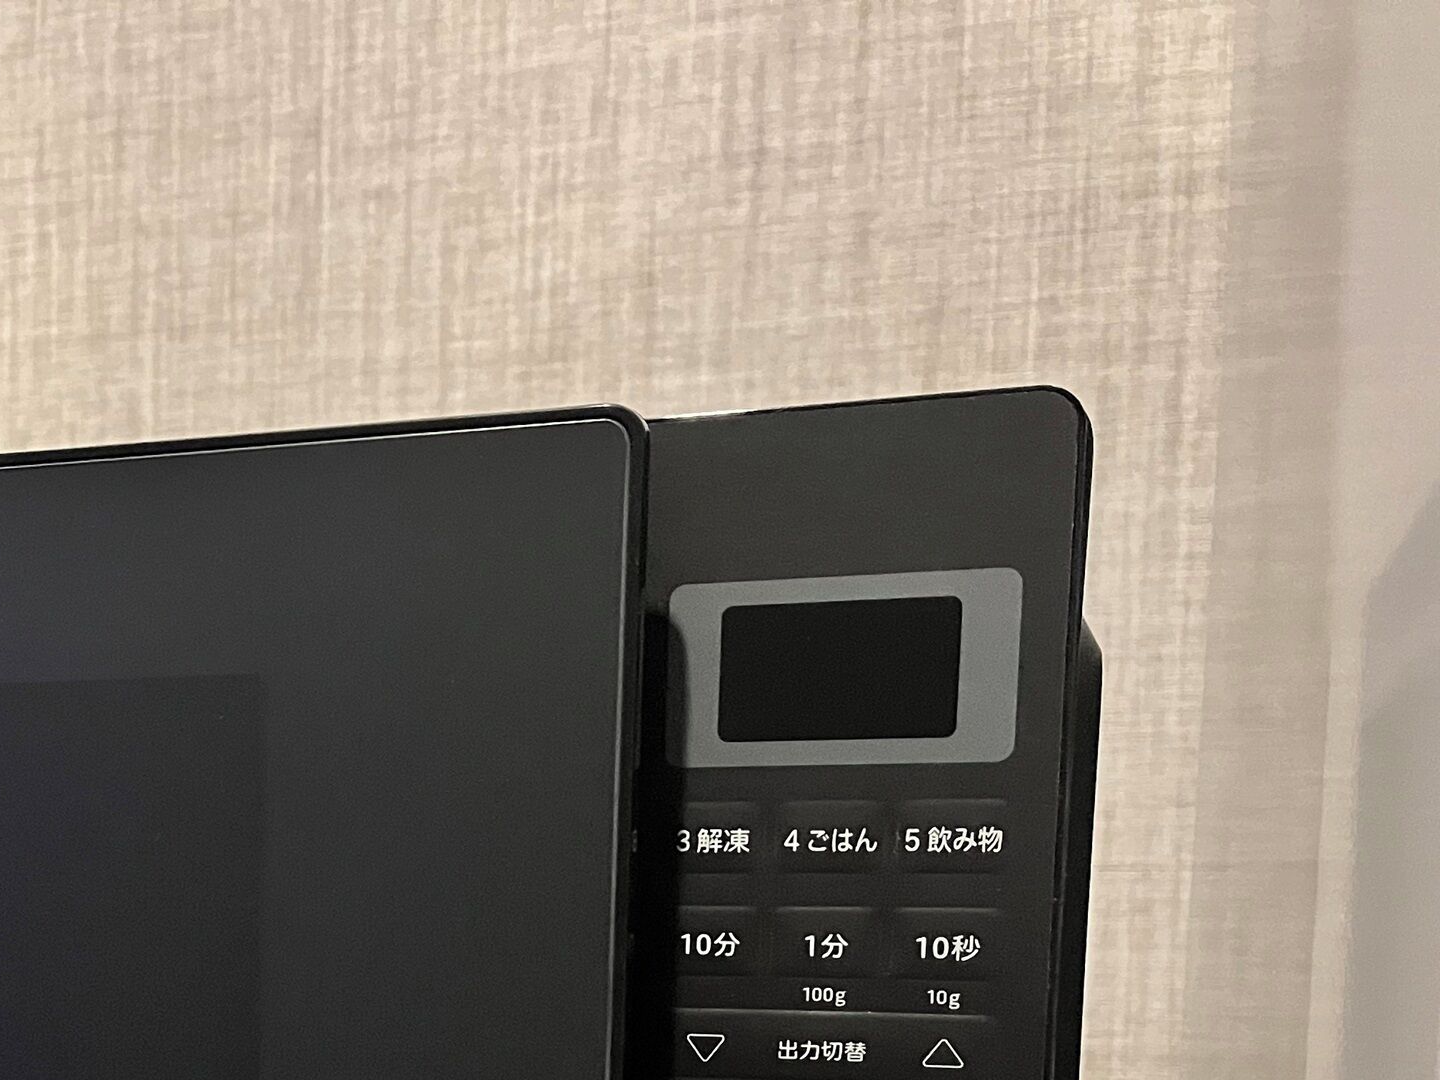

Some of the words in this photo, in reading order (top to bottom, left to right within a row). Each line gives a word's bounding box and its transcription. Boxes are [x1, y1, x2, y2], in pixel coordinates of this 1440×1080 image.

[677, 829, 691, 853] 3
[696, 827, 750, 854] 解凍
[783, 828, 800, 852] 4
[807, 827, 878, 853] ごはん
[904, 828, 921, 852] 5
[926, 825, 1003, 854] 飲み物
[680, 932, 741, 957] 10分
[804, 933, 849, 959] 1分
[915, 934, 981, 962] 10秒
[802, 986, 847, 1007] 100g
[927, 989, 961, 1010] 10g
[777, 1039, 867, 1063] 出力切替
